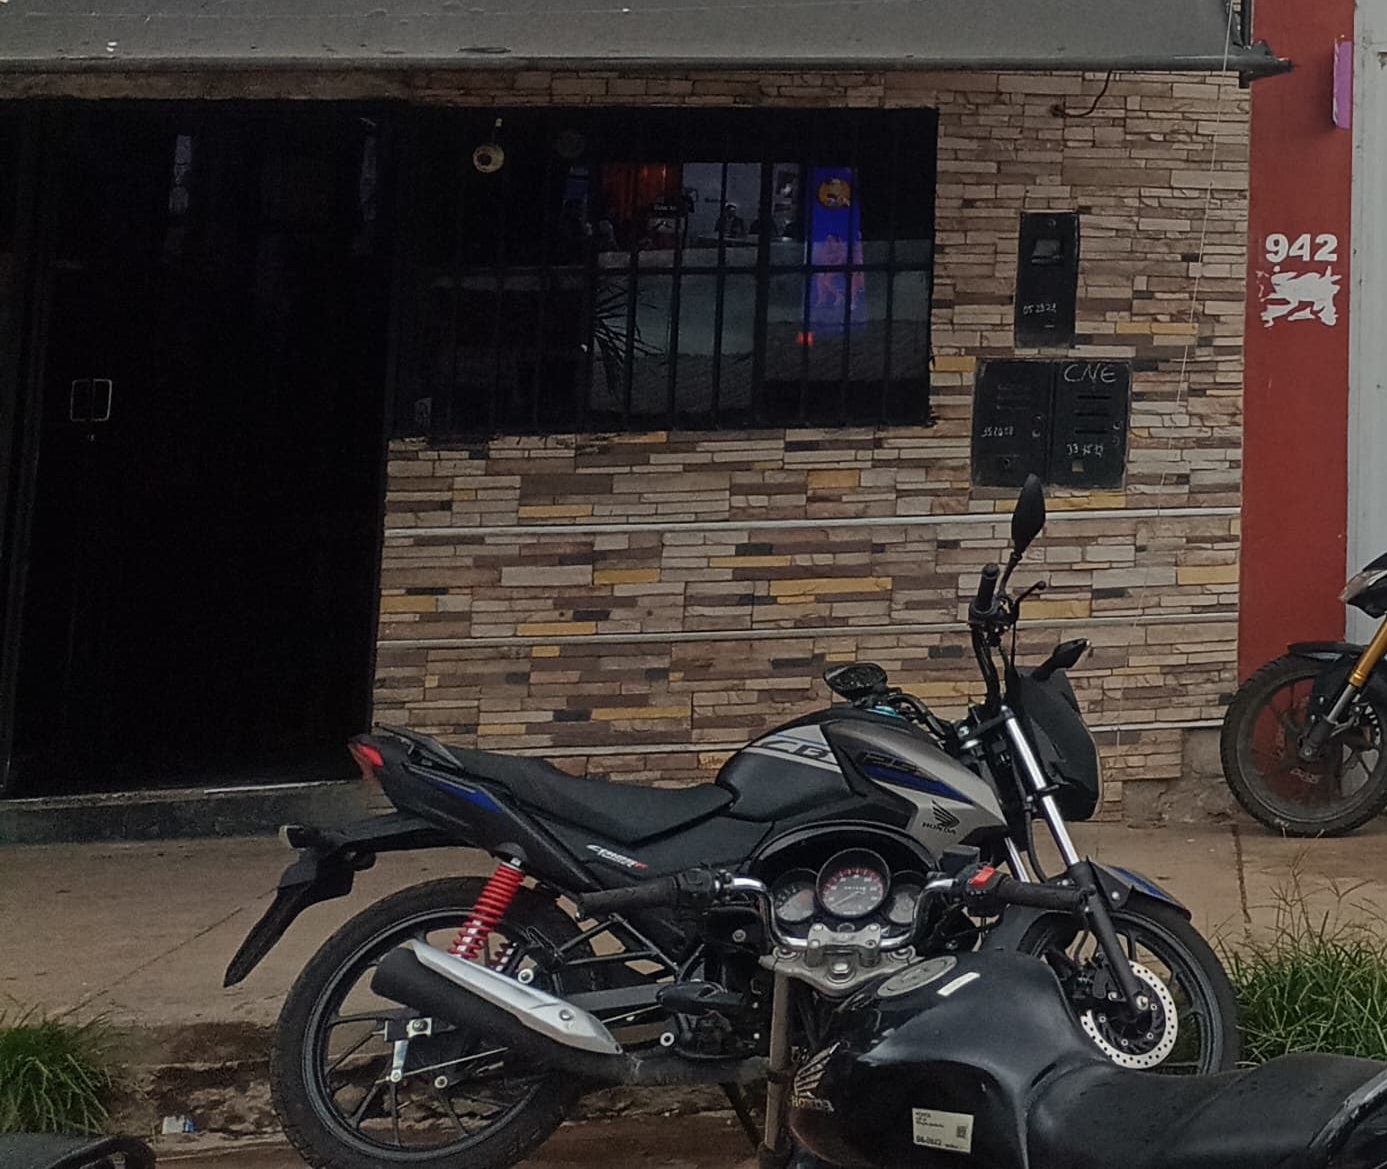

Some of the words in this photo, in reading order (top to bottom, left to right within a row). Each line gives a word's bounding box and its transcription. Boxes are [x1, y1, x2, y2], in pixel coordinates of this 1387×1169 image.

[1265, 233, 1338, 263] 942
[1064, 362, 1117, 384] CNE
[921, 821, 957, 835] HONDA
